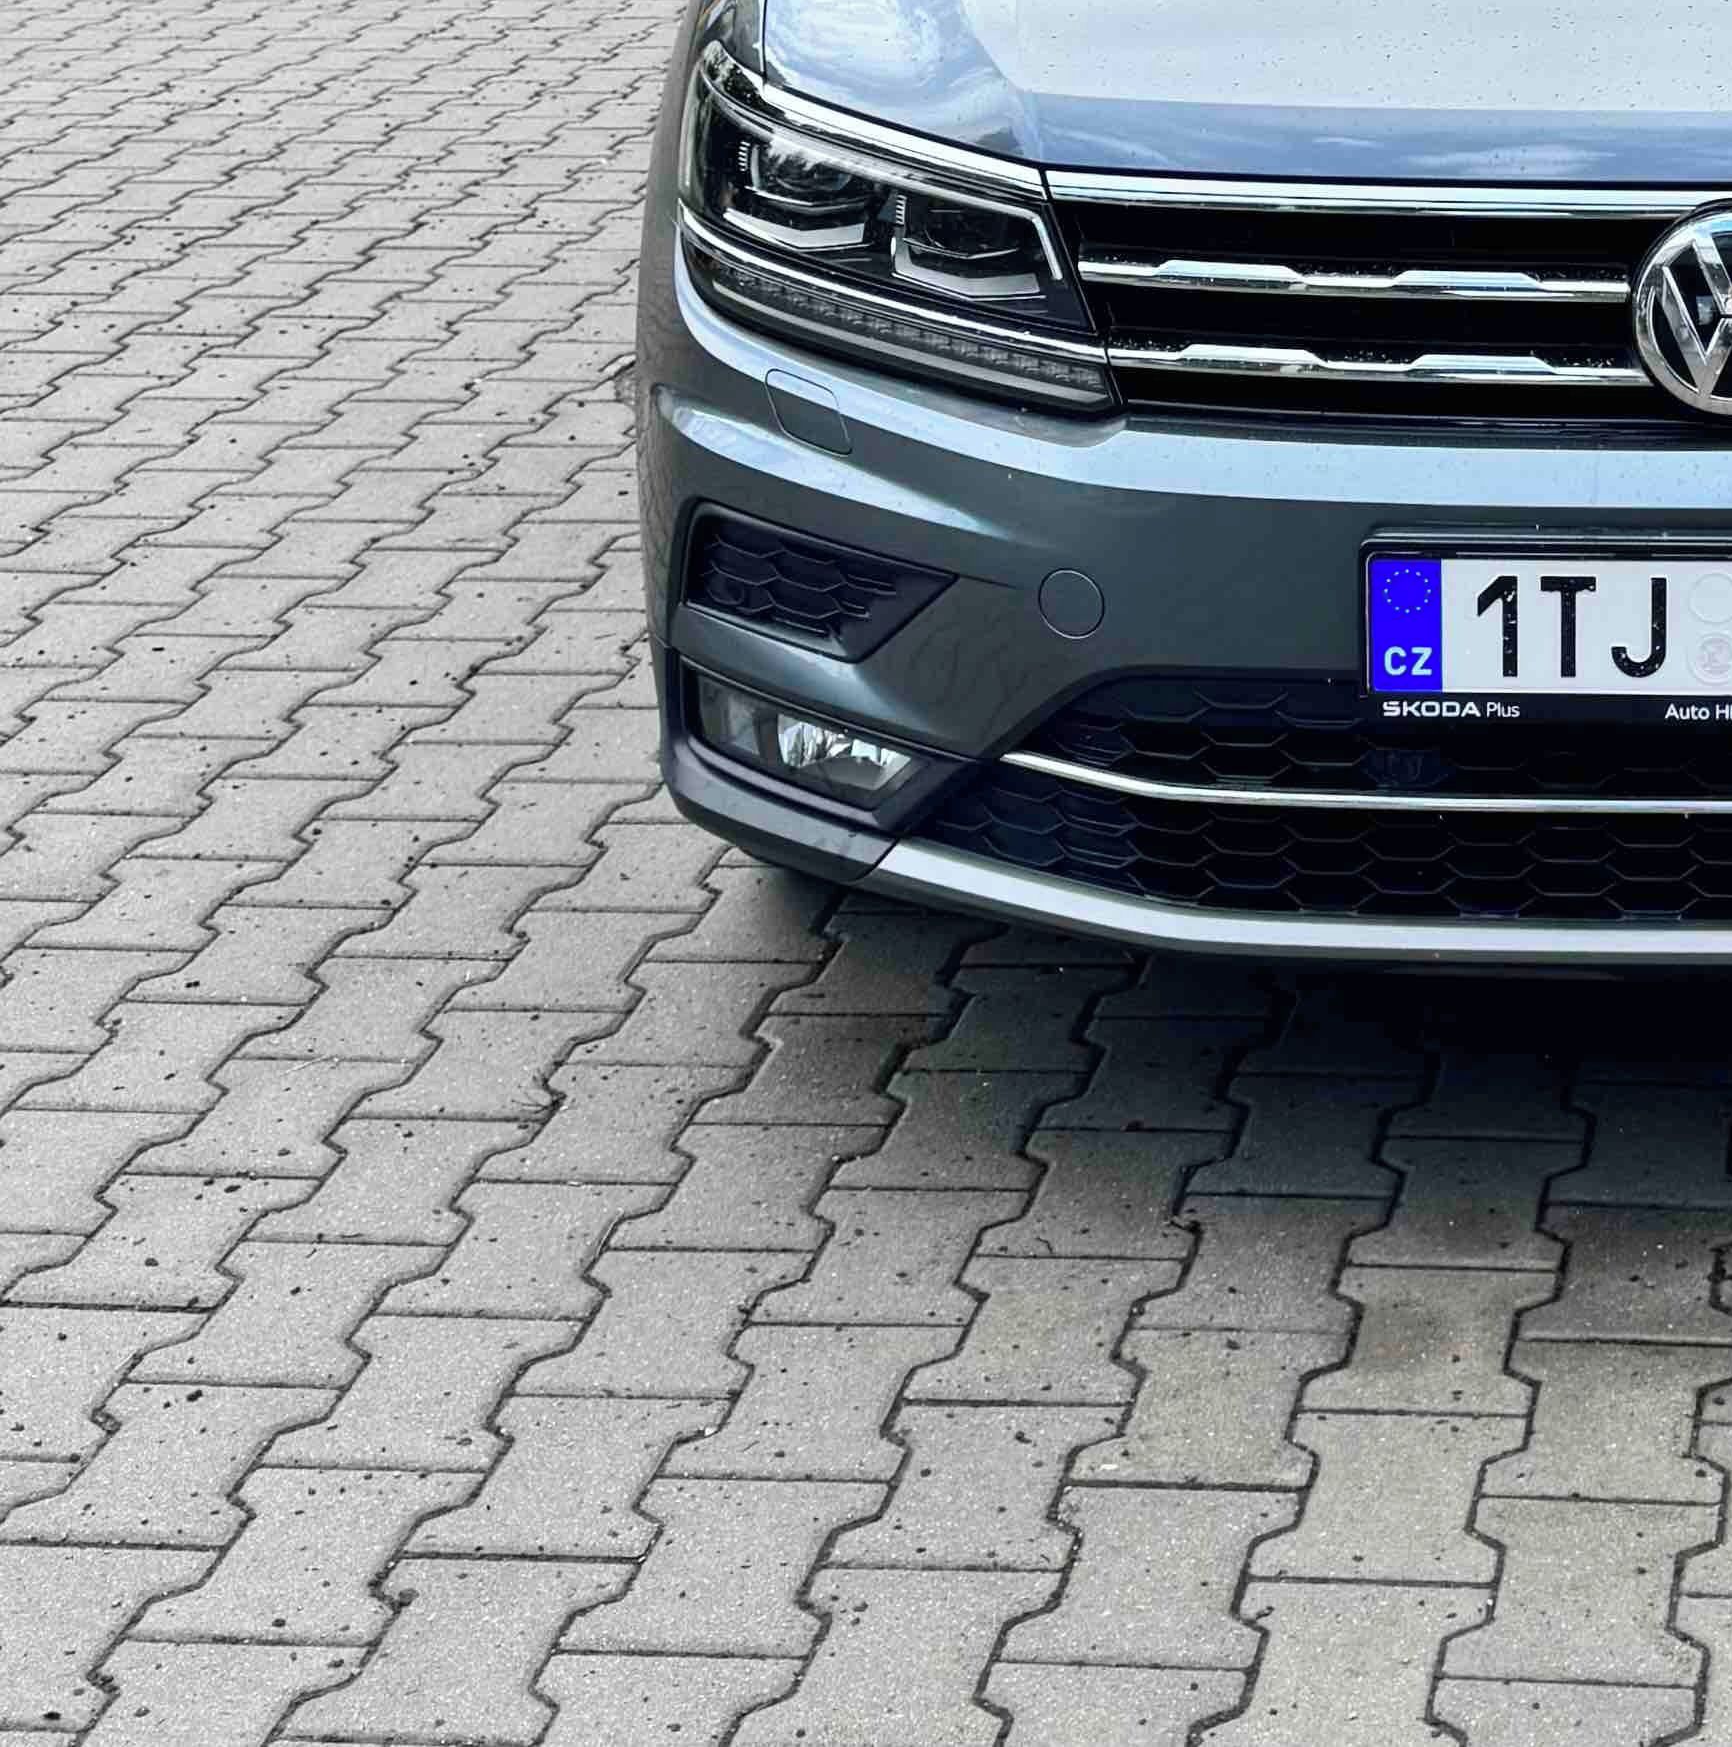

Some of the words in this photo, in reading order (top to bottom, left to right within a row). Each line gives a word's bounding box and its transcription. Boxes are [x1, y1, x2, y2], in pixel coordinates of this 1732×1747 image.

[1477, 575, 1667, 678] 1TJ
[1384, 646, 1432, 676] CZ
[1486, 702, 1520, 717] Plus
[1665, 703, 1710, 720] Auto
